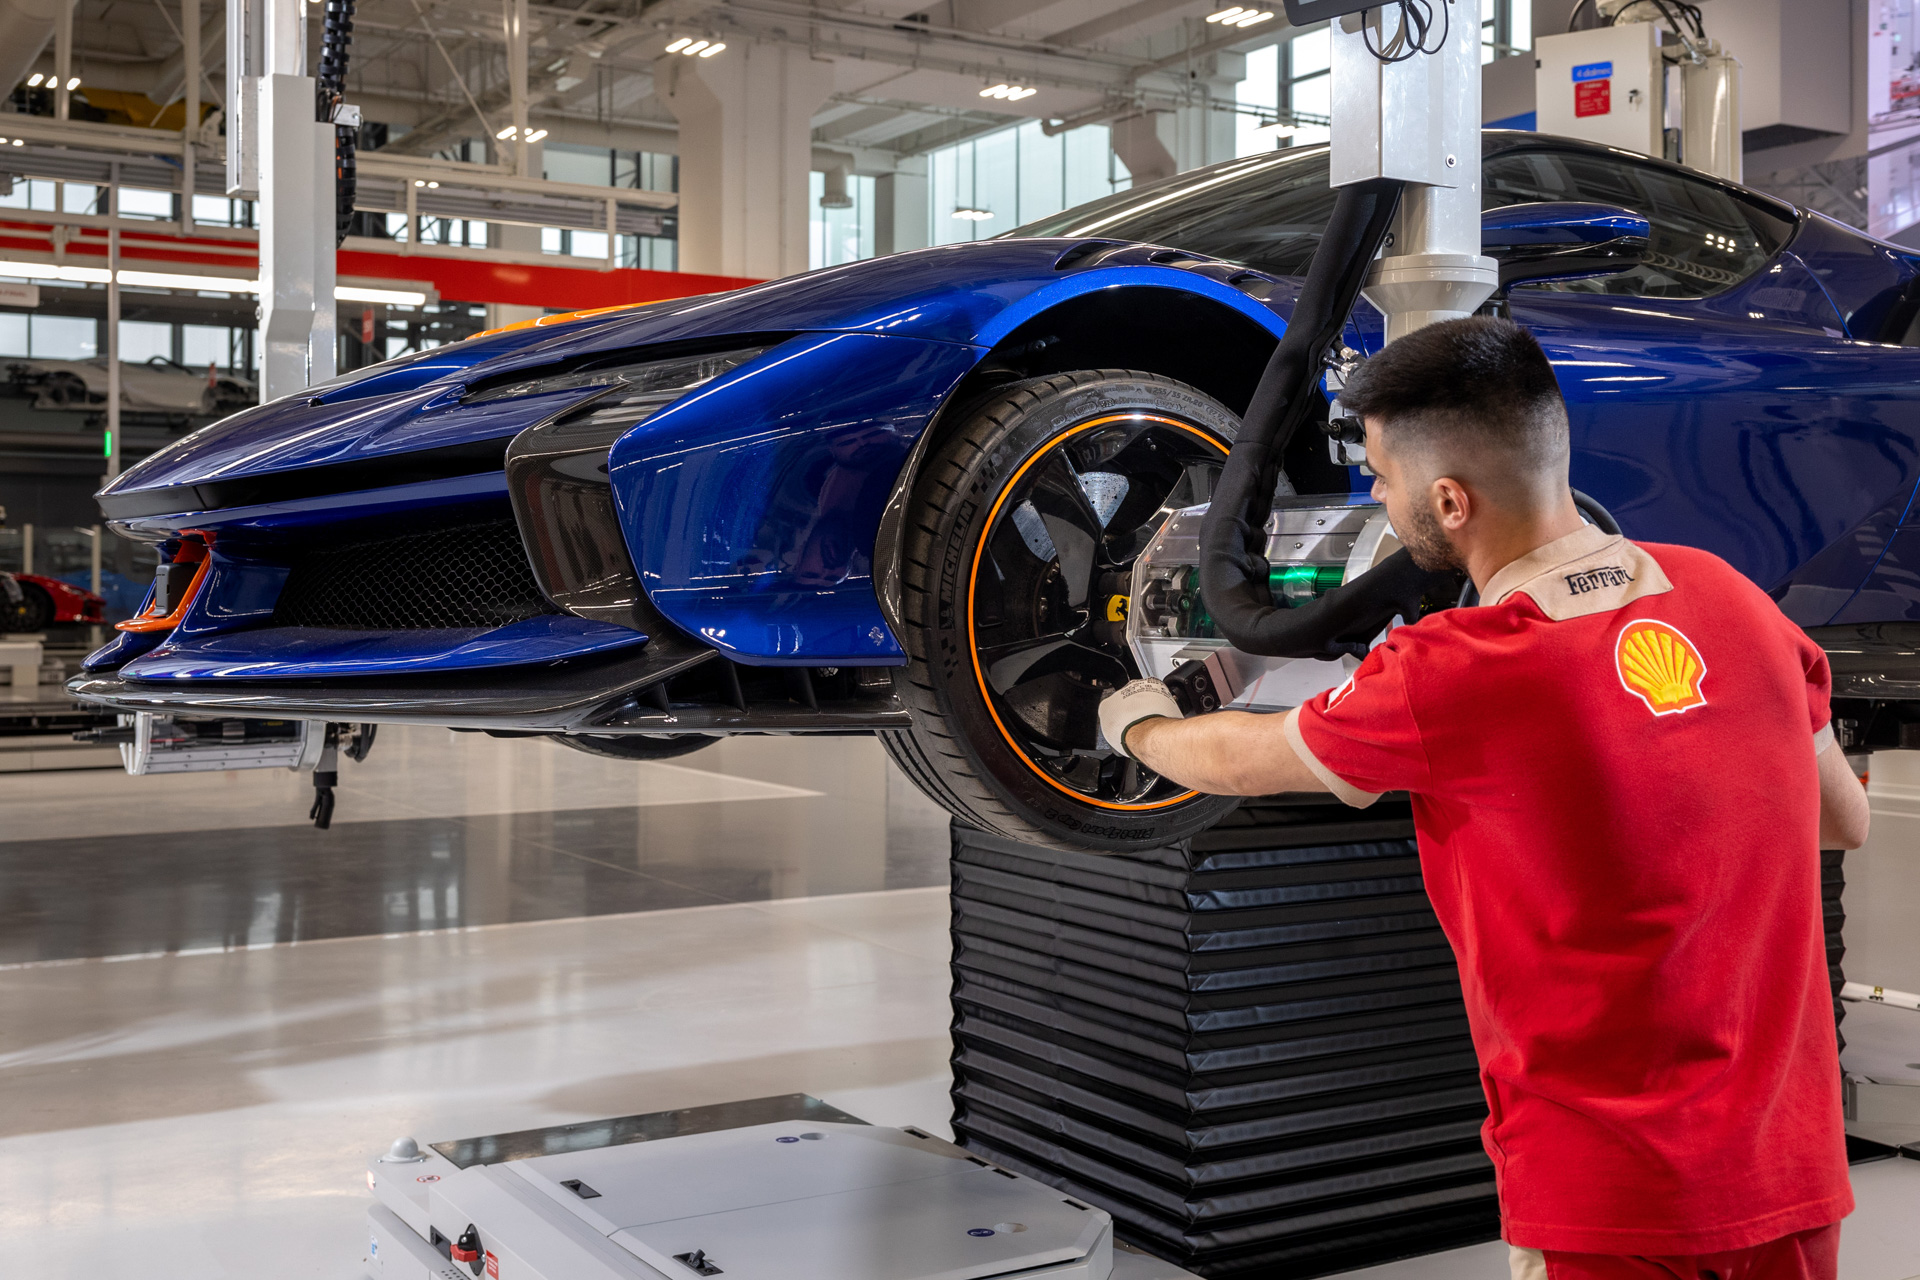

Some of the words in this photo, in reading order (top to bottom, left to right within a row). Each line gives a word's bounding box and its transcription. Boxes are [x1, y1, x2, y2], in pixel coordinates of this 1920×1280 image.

[940, 499, 974, 603] MICHELIN
[1564, 566, 1635, 595] Ferrari
[1044, 808, 1059, 820] 2
[1058, 814, 1082, 830] Cup
[1081, 823, 1121, 839] Sport
[1120, 827, 1155, 840] Pilot
